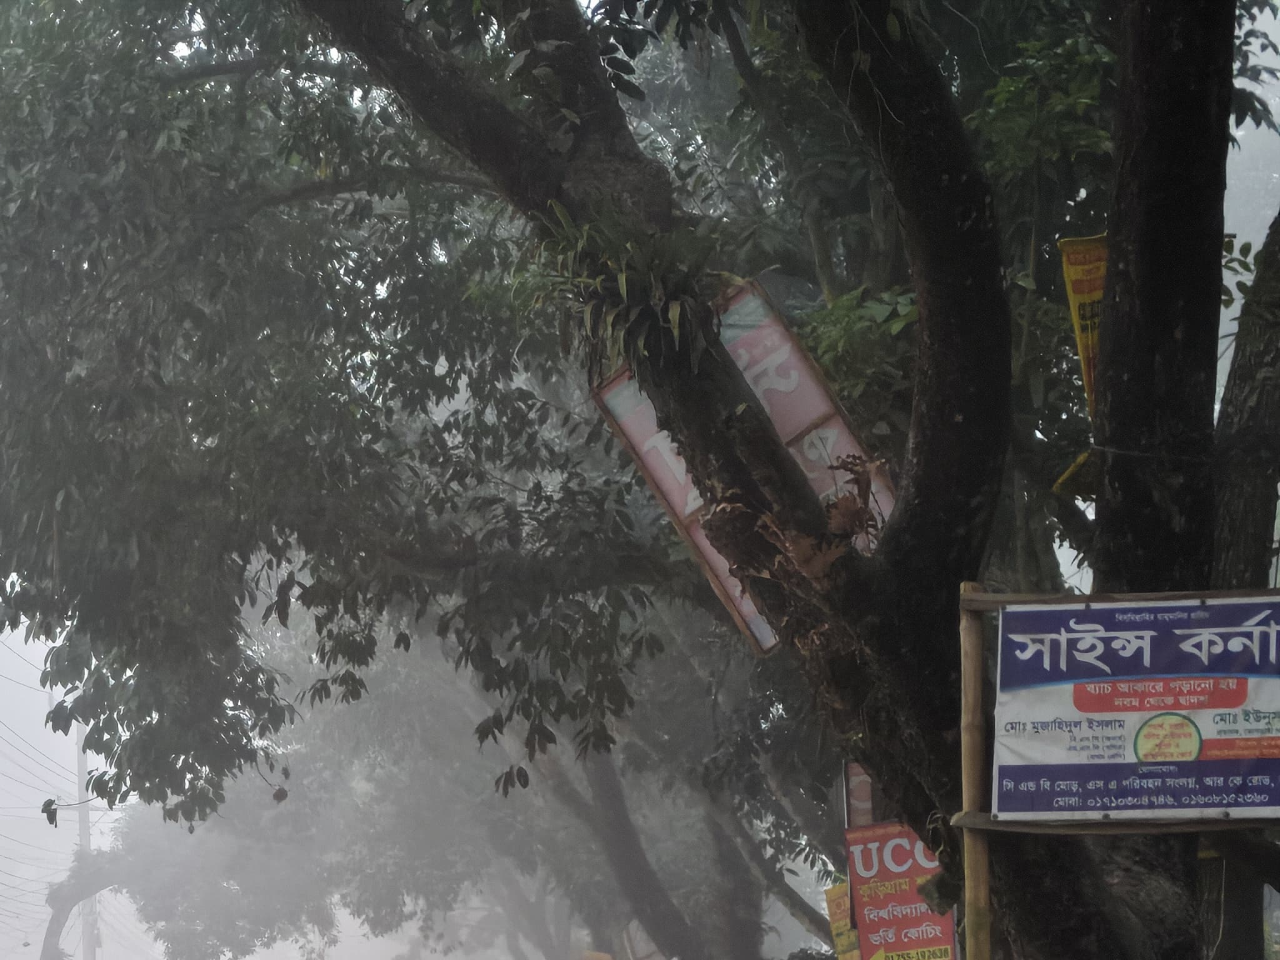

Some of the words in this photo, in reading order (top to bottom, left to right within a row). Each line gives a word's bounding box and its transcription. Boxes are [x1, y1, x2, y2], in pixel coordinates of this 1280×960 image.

[1007, 617, 1158, 675] সাইন্স
[1086, 717, 1125, 732] ইসলাম
[864, 901, 933, 924] বিশ্ববিদ্যাল
[867, 926, 897, 945] ভর্তি
[901, 921, 943, 943] কোচিং
